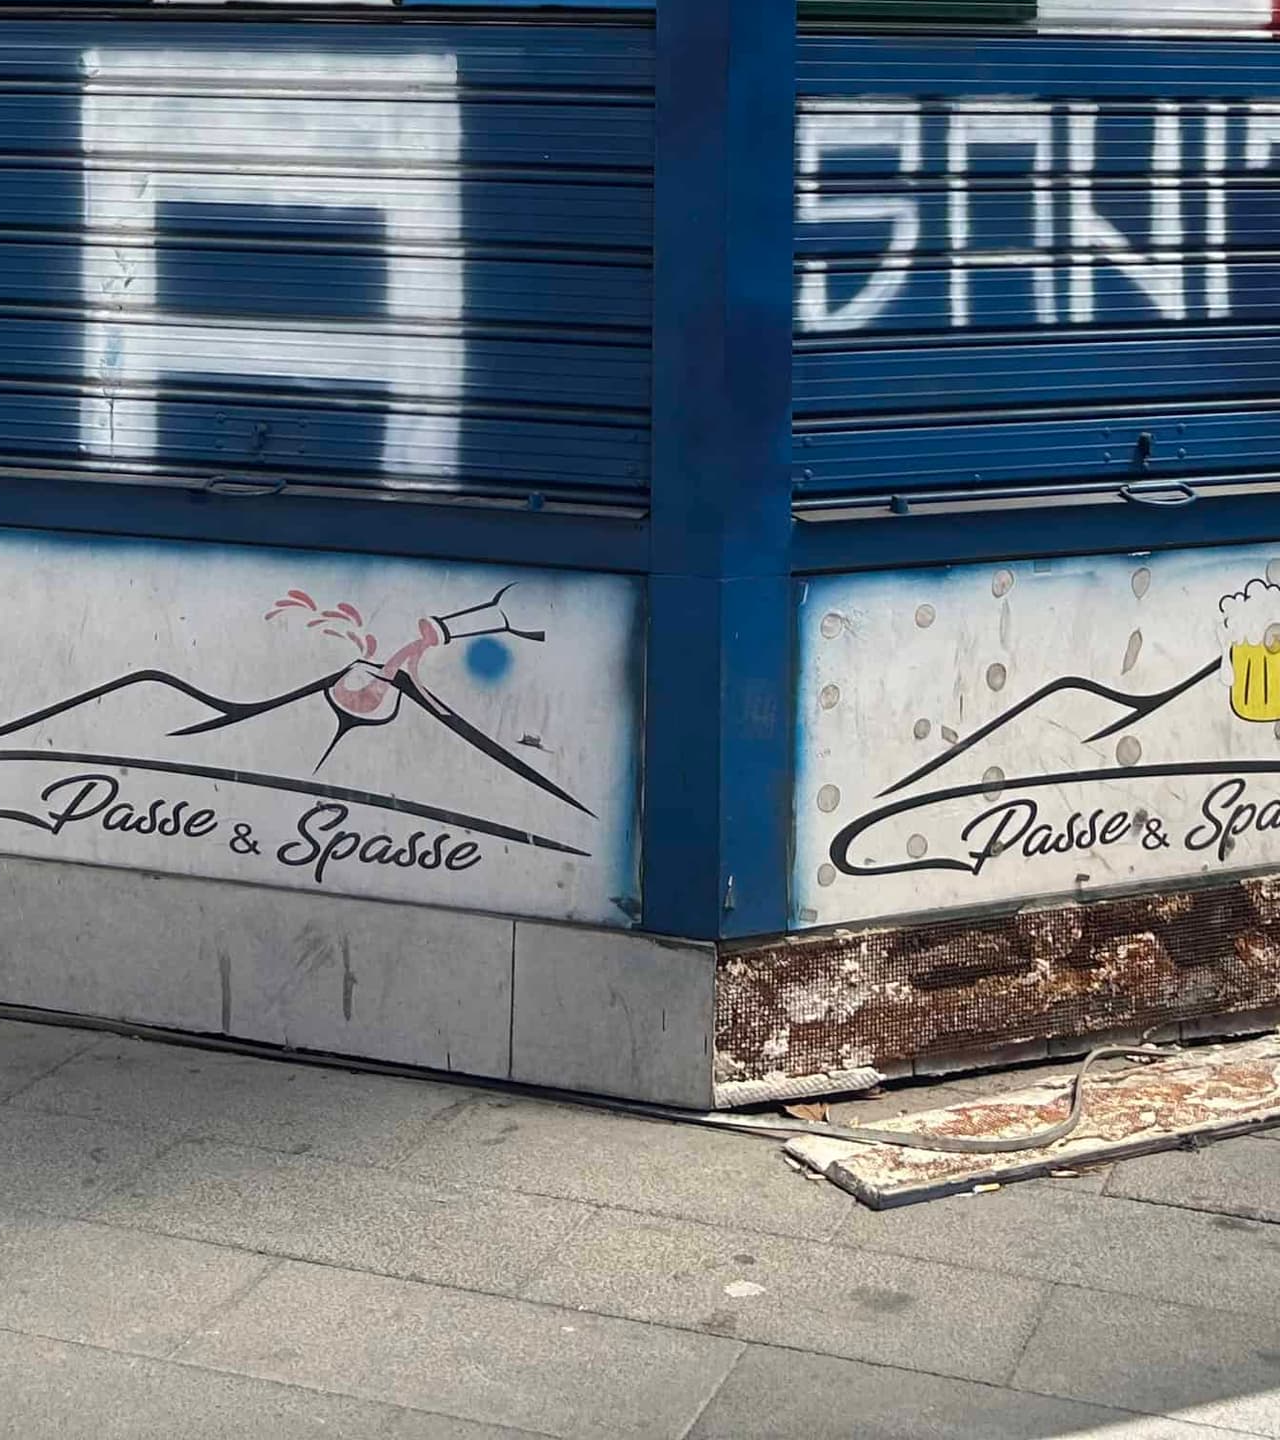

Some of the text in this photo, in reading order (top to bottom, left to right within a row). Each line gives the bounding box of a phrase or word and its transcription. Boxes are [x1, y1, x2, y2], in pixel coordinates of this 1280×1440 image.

[79, 48, 463, 489] A
[41, 774, 482, 882] Passe & Spasse
[961, 799, 1132, 875] Passe
[1142, 818, 1170, 849] &
